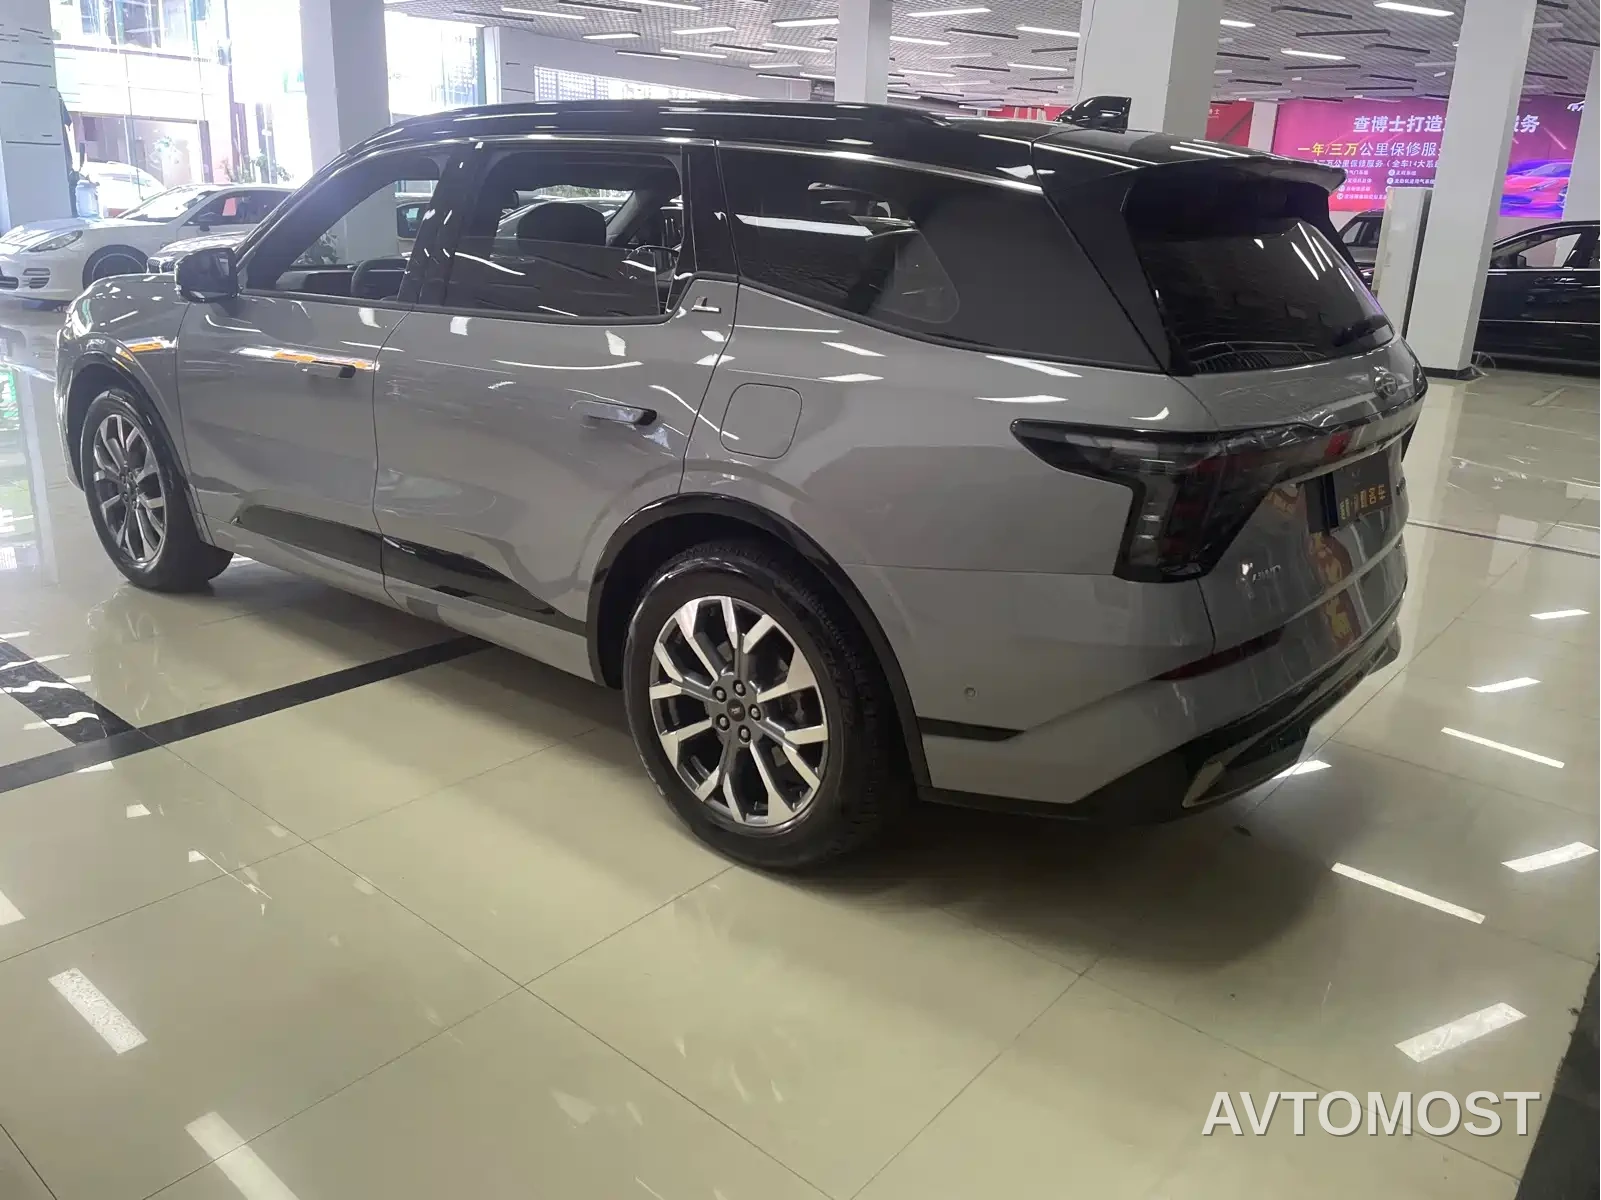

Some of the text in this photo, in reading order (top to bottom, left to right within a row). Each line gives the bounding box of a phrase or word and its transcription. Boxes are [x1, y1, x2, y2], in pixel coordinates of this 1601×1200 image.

[1353, 115, 1446, 133] 查博士打造
[1298, 142, 1441, 157] 一年/三万公里保修服
